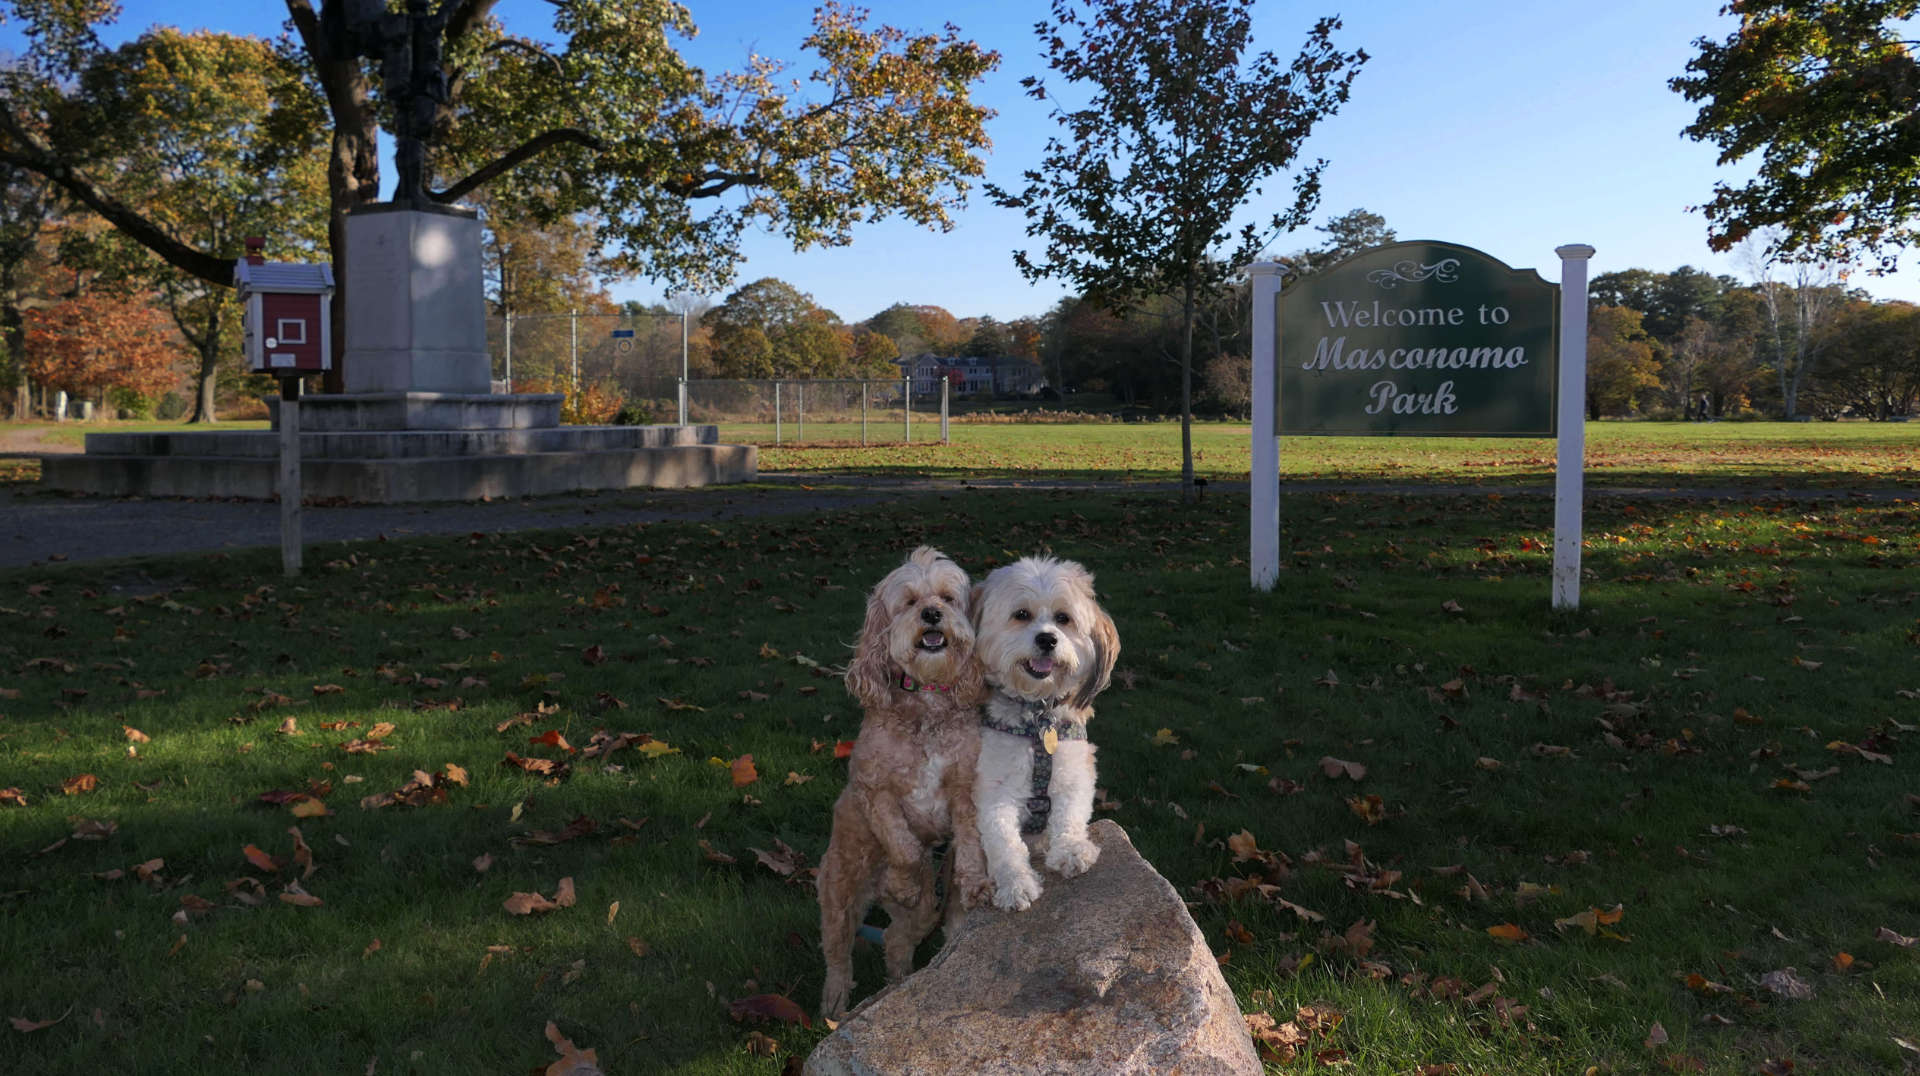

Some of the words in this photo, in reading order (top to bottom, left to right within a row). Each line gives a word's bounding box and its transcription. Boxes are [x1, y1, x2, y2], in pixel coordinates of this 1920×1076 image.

[1320, 300, 1465, 328] Welcome
[1478, 303, 1510, 326] to
[1302, 336, 1529, 371] Masconomo
[1364, 380, 1459, 415] Park
